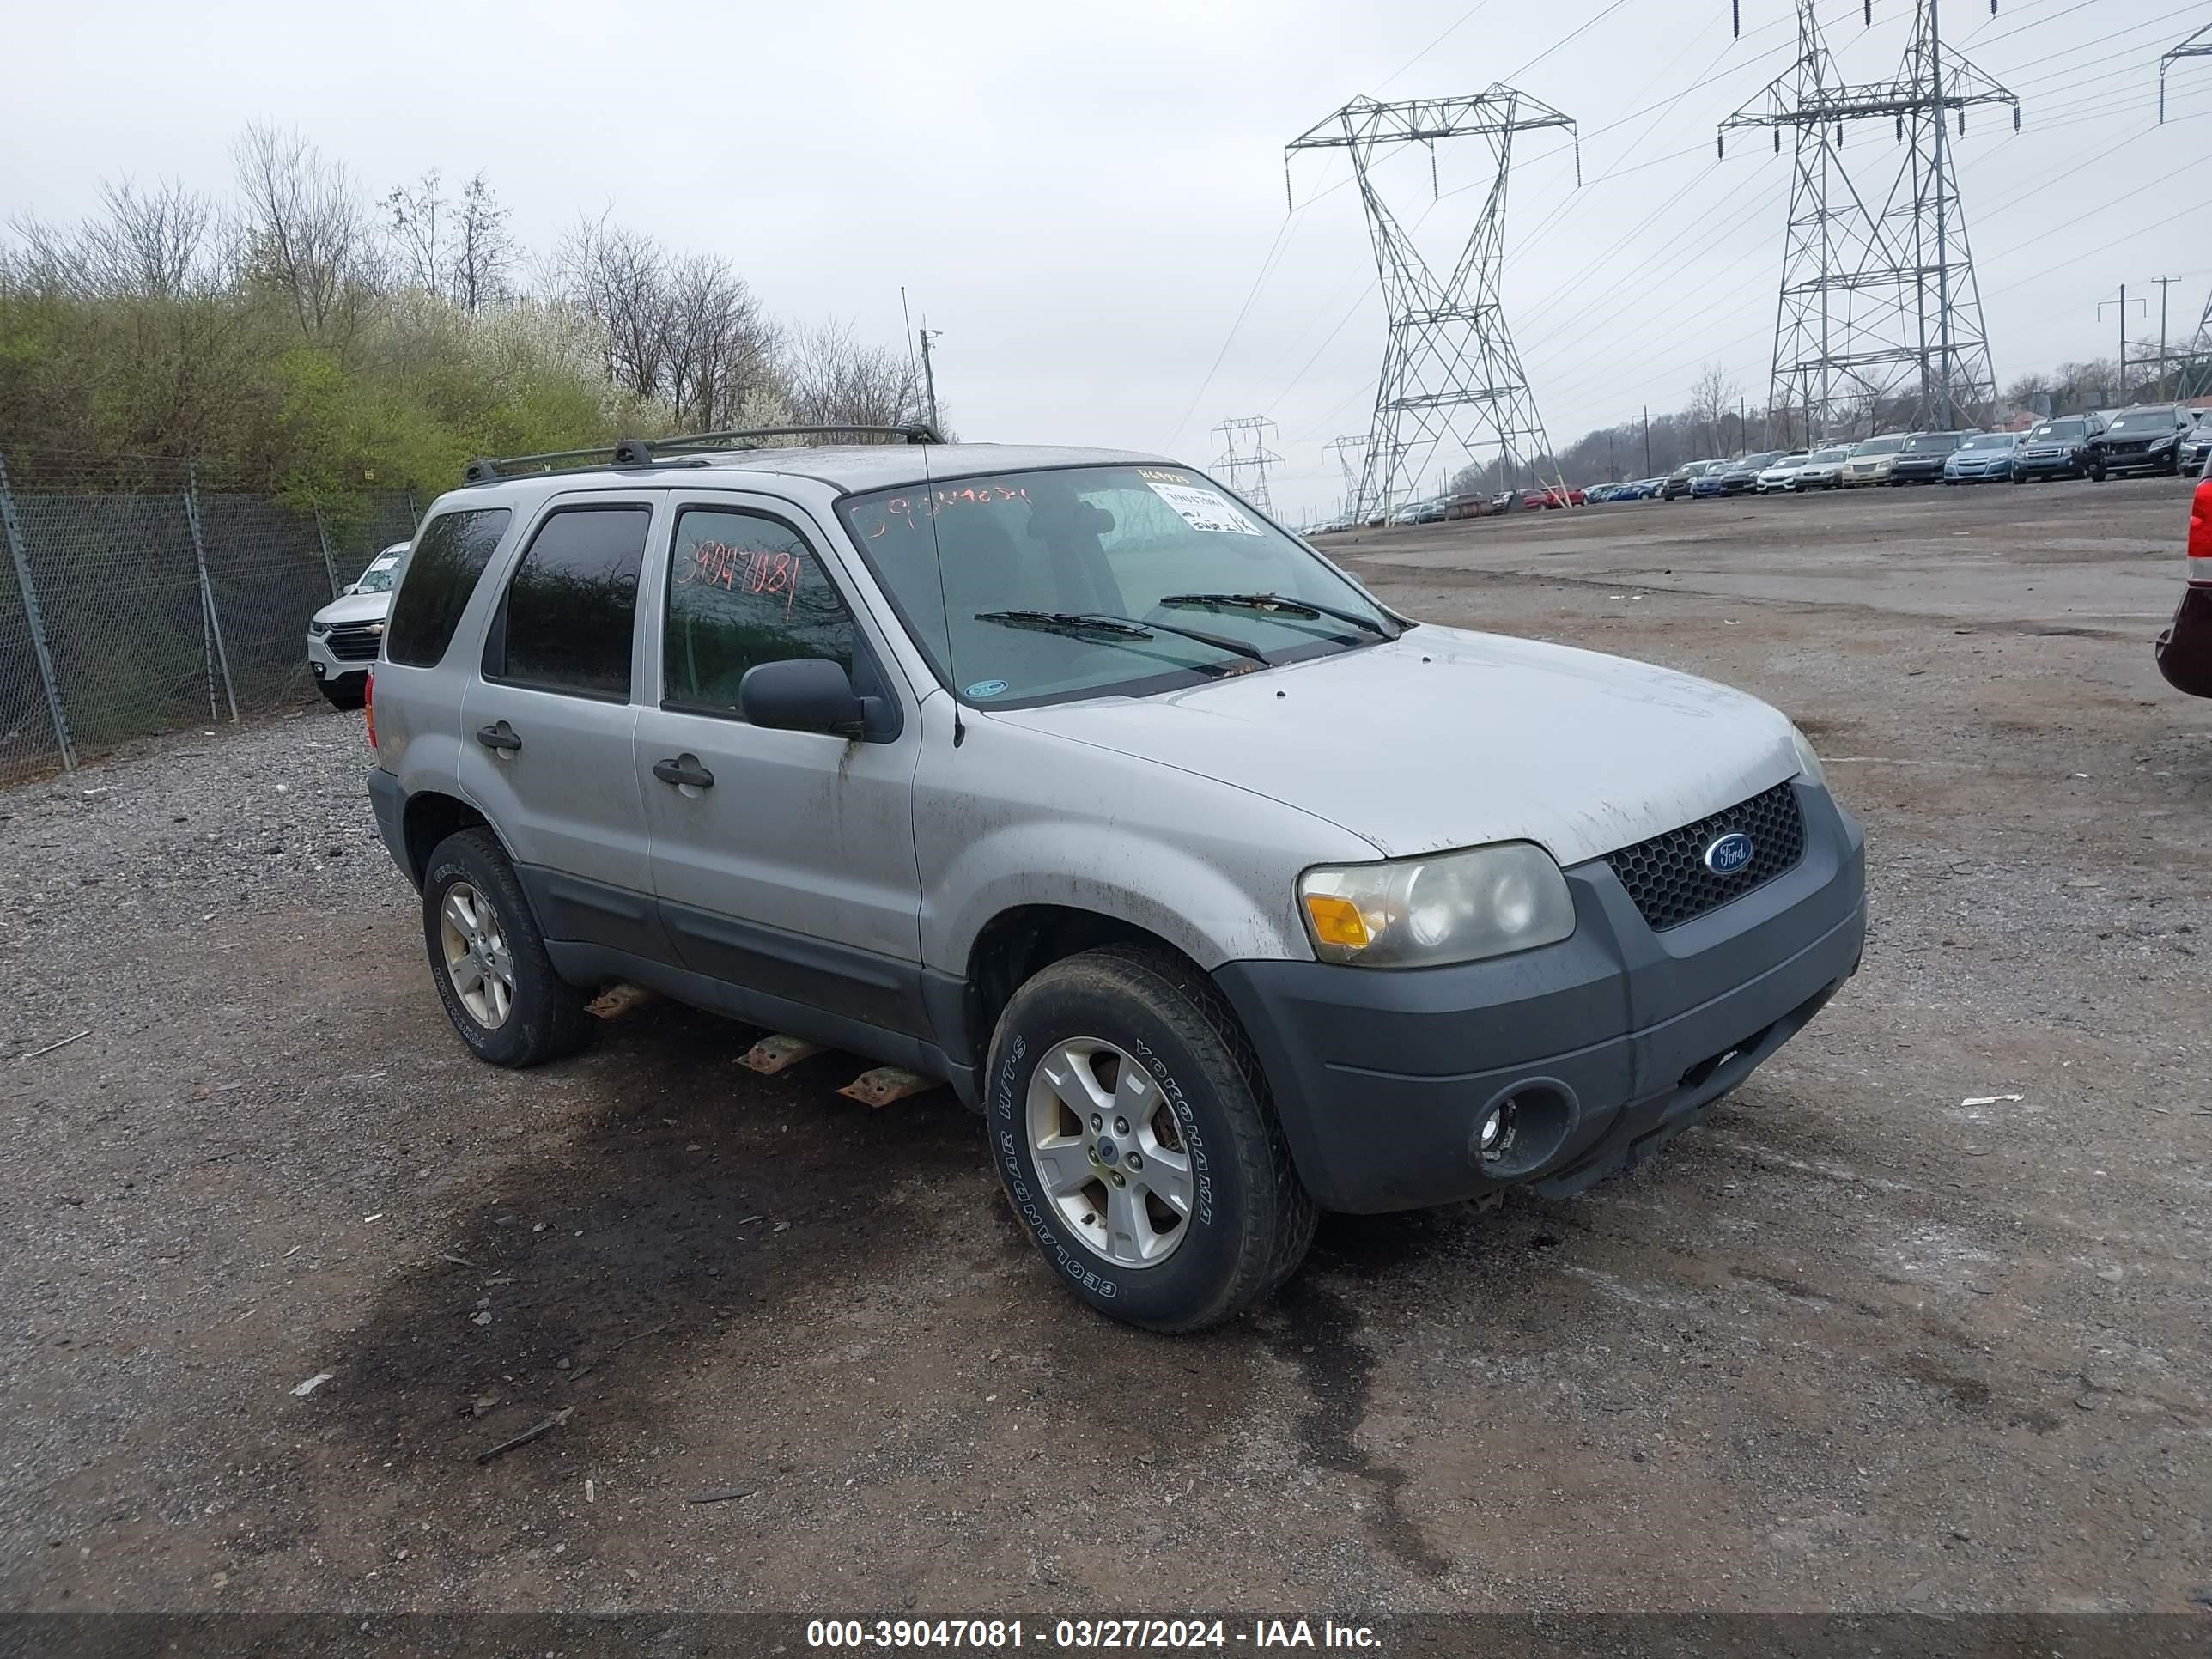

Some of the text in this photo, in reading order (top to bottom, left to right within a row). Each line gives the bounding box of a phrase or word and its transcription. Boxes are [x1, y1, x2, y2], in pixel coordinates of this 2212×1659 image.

[677, 538, 800, 606] 39047081
[1000, 1129, 1120, 1299] GEOLANDAR
[1135, 1037, 1214, 1225] YOKOHAMA
